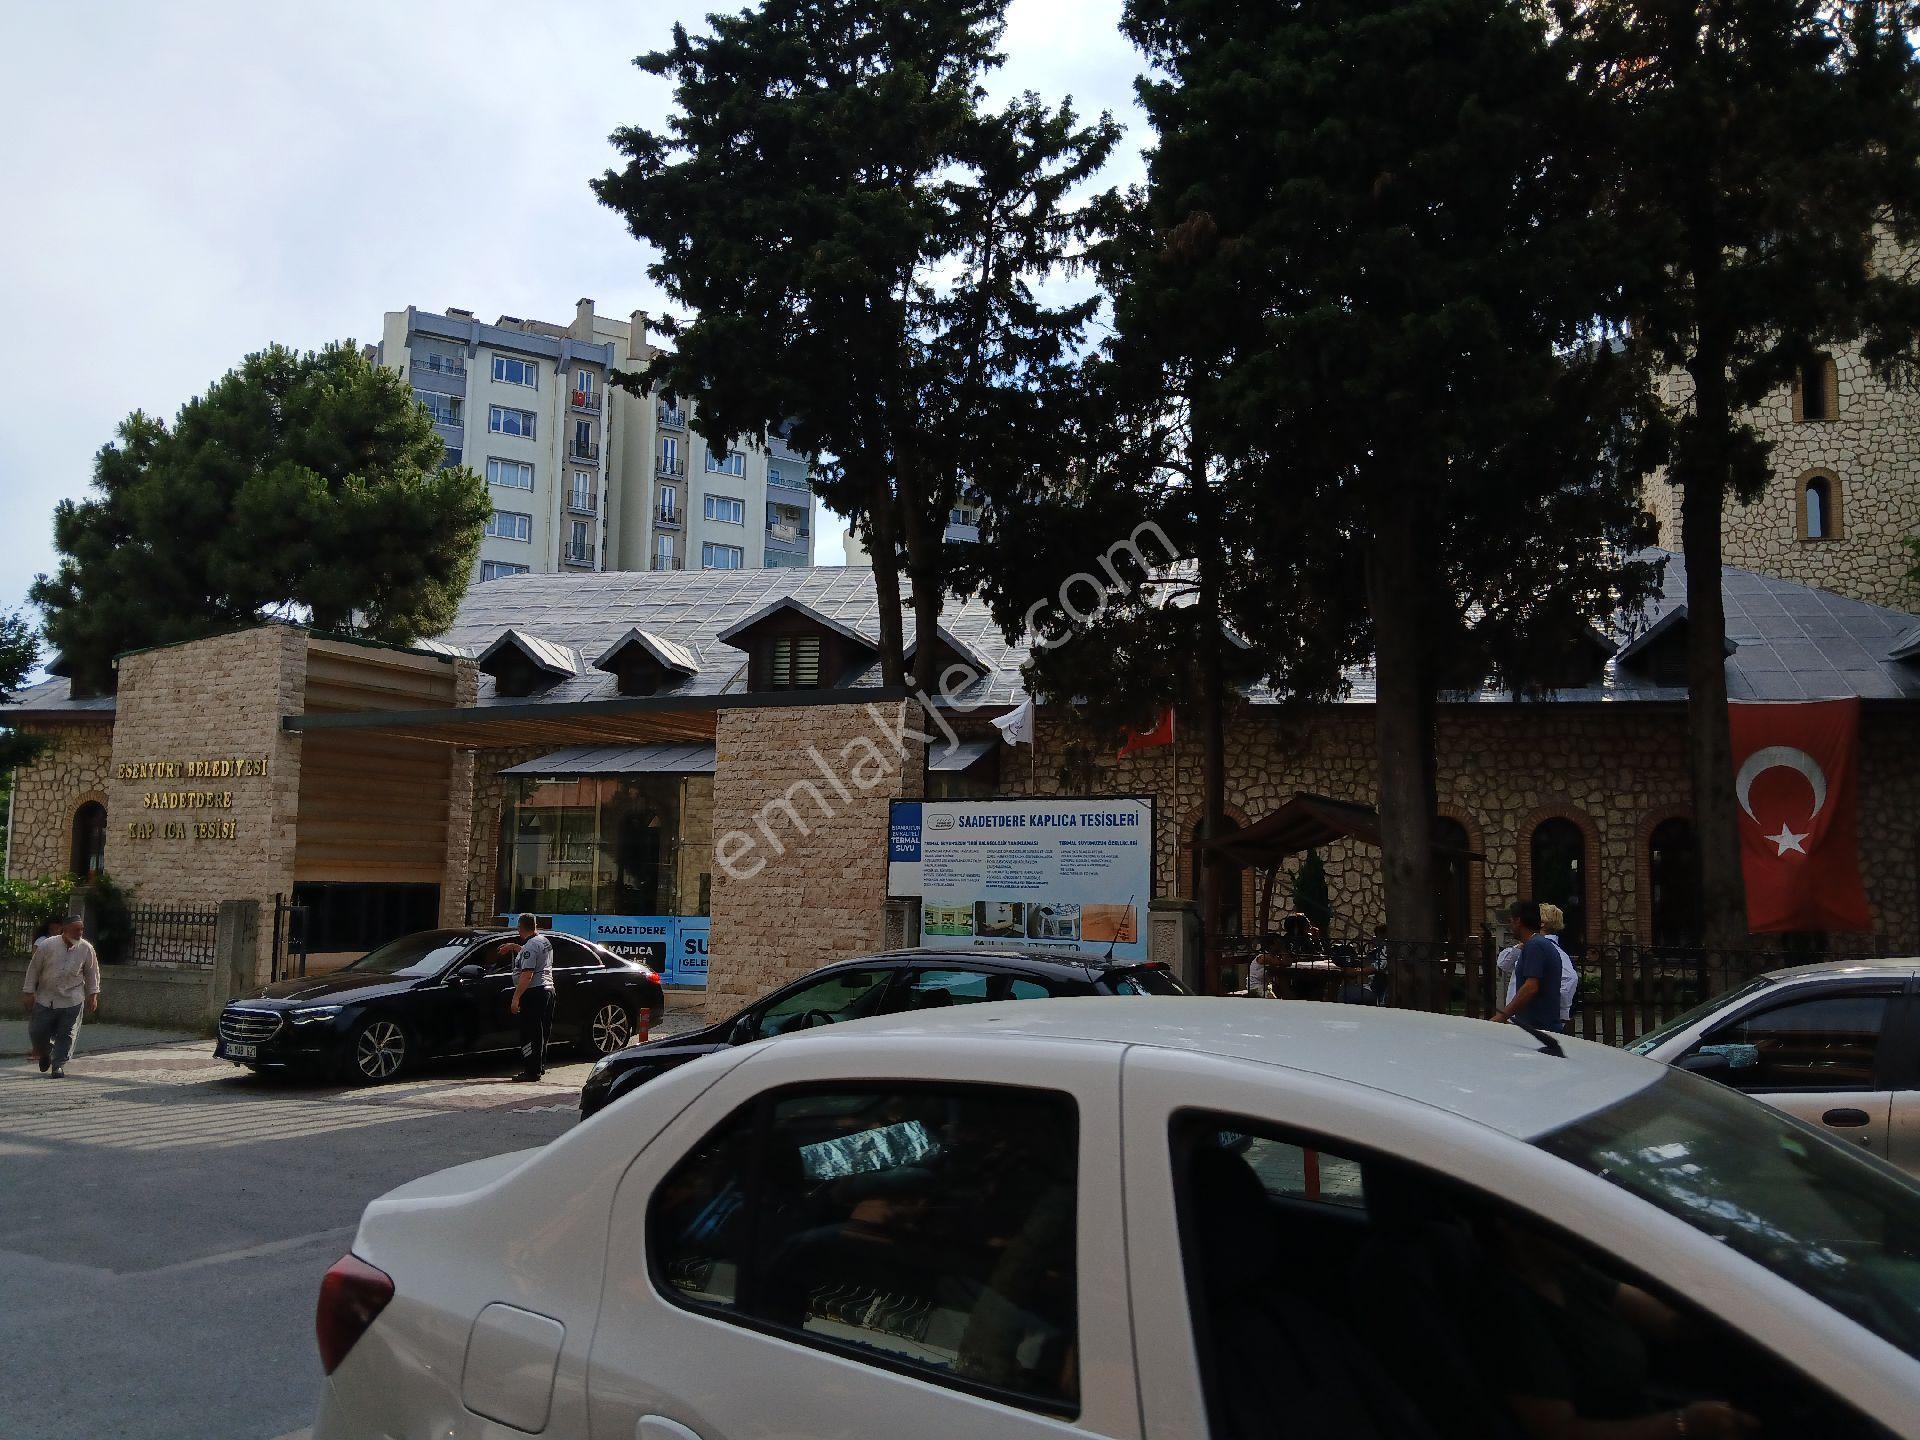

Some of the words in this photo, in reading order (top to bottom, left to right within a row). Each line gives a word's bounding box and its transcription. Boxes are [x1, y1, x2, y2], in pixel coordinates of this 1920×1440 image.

[118, 761, 183, 778] ESENYURT
[144, 791, 233, 809] SAADETDERE
[958, 814, 1025, 828] SAADETDERE
[1029, 814, 1077, 827] KAPLICA
[1080, 810, 1139, 827] TESİSLERİ
[895, 844, 915, 852] SUYU
[597, 925, 667, 935] SAADETDERE
[608, 945, 653, 955] KAPLICA
[682, 959, 709, 967] GELE
